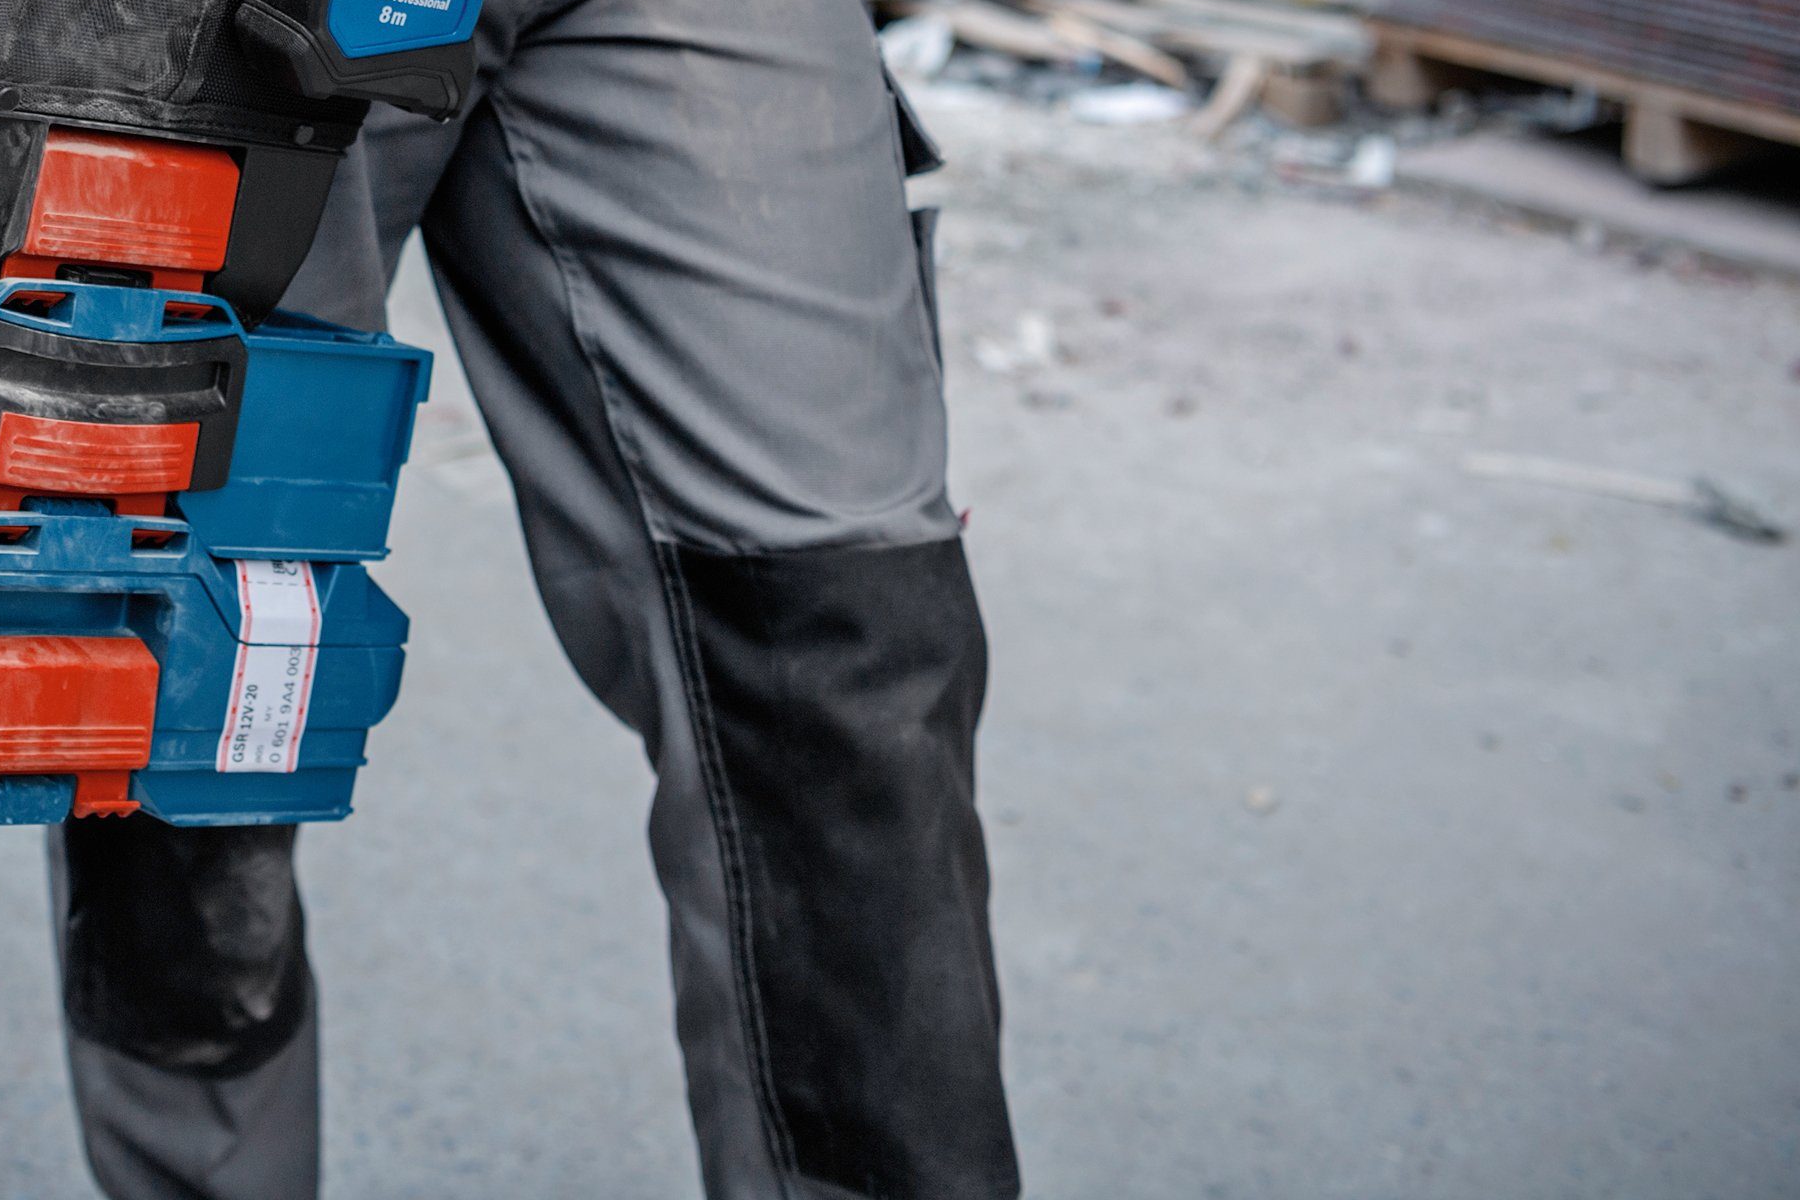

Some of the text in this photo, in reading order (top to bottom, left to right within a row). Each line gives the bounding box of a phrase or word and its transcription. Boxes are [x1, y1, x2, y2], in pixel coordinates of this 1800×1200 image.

[378, 5, 408, 27] 8m
[286, 645, 303, 677] 003
[279, 681, 296, 715] 9A4
[232, 683, 259, 763] GSR 12V-20
[274, 720, 290, 749] 601
